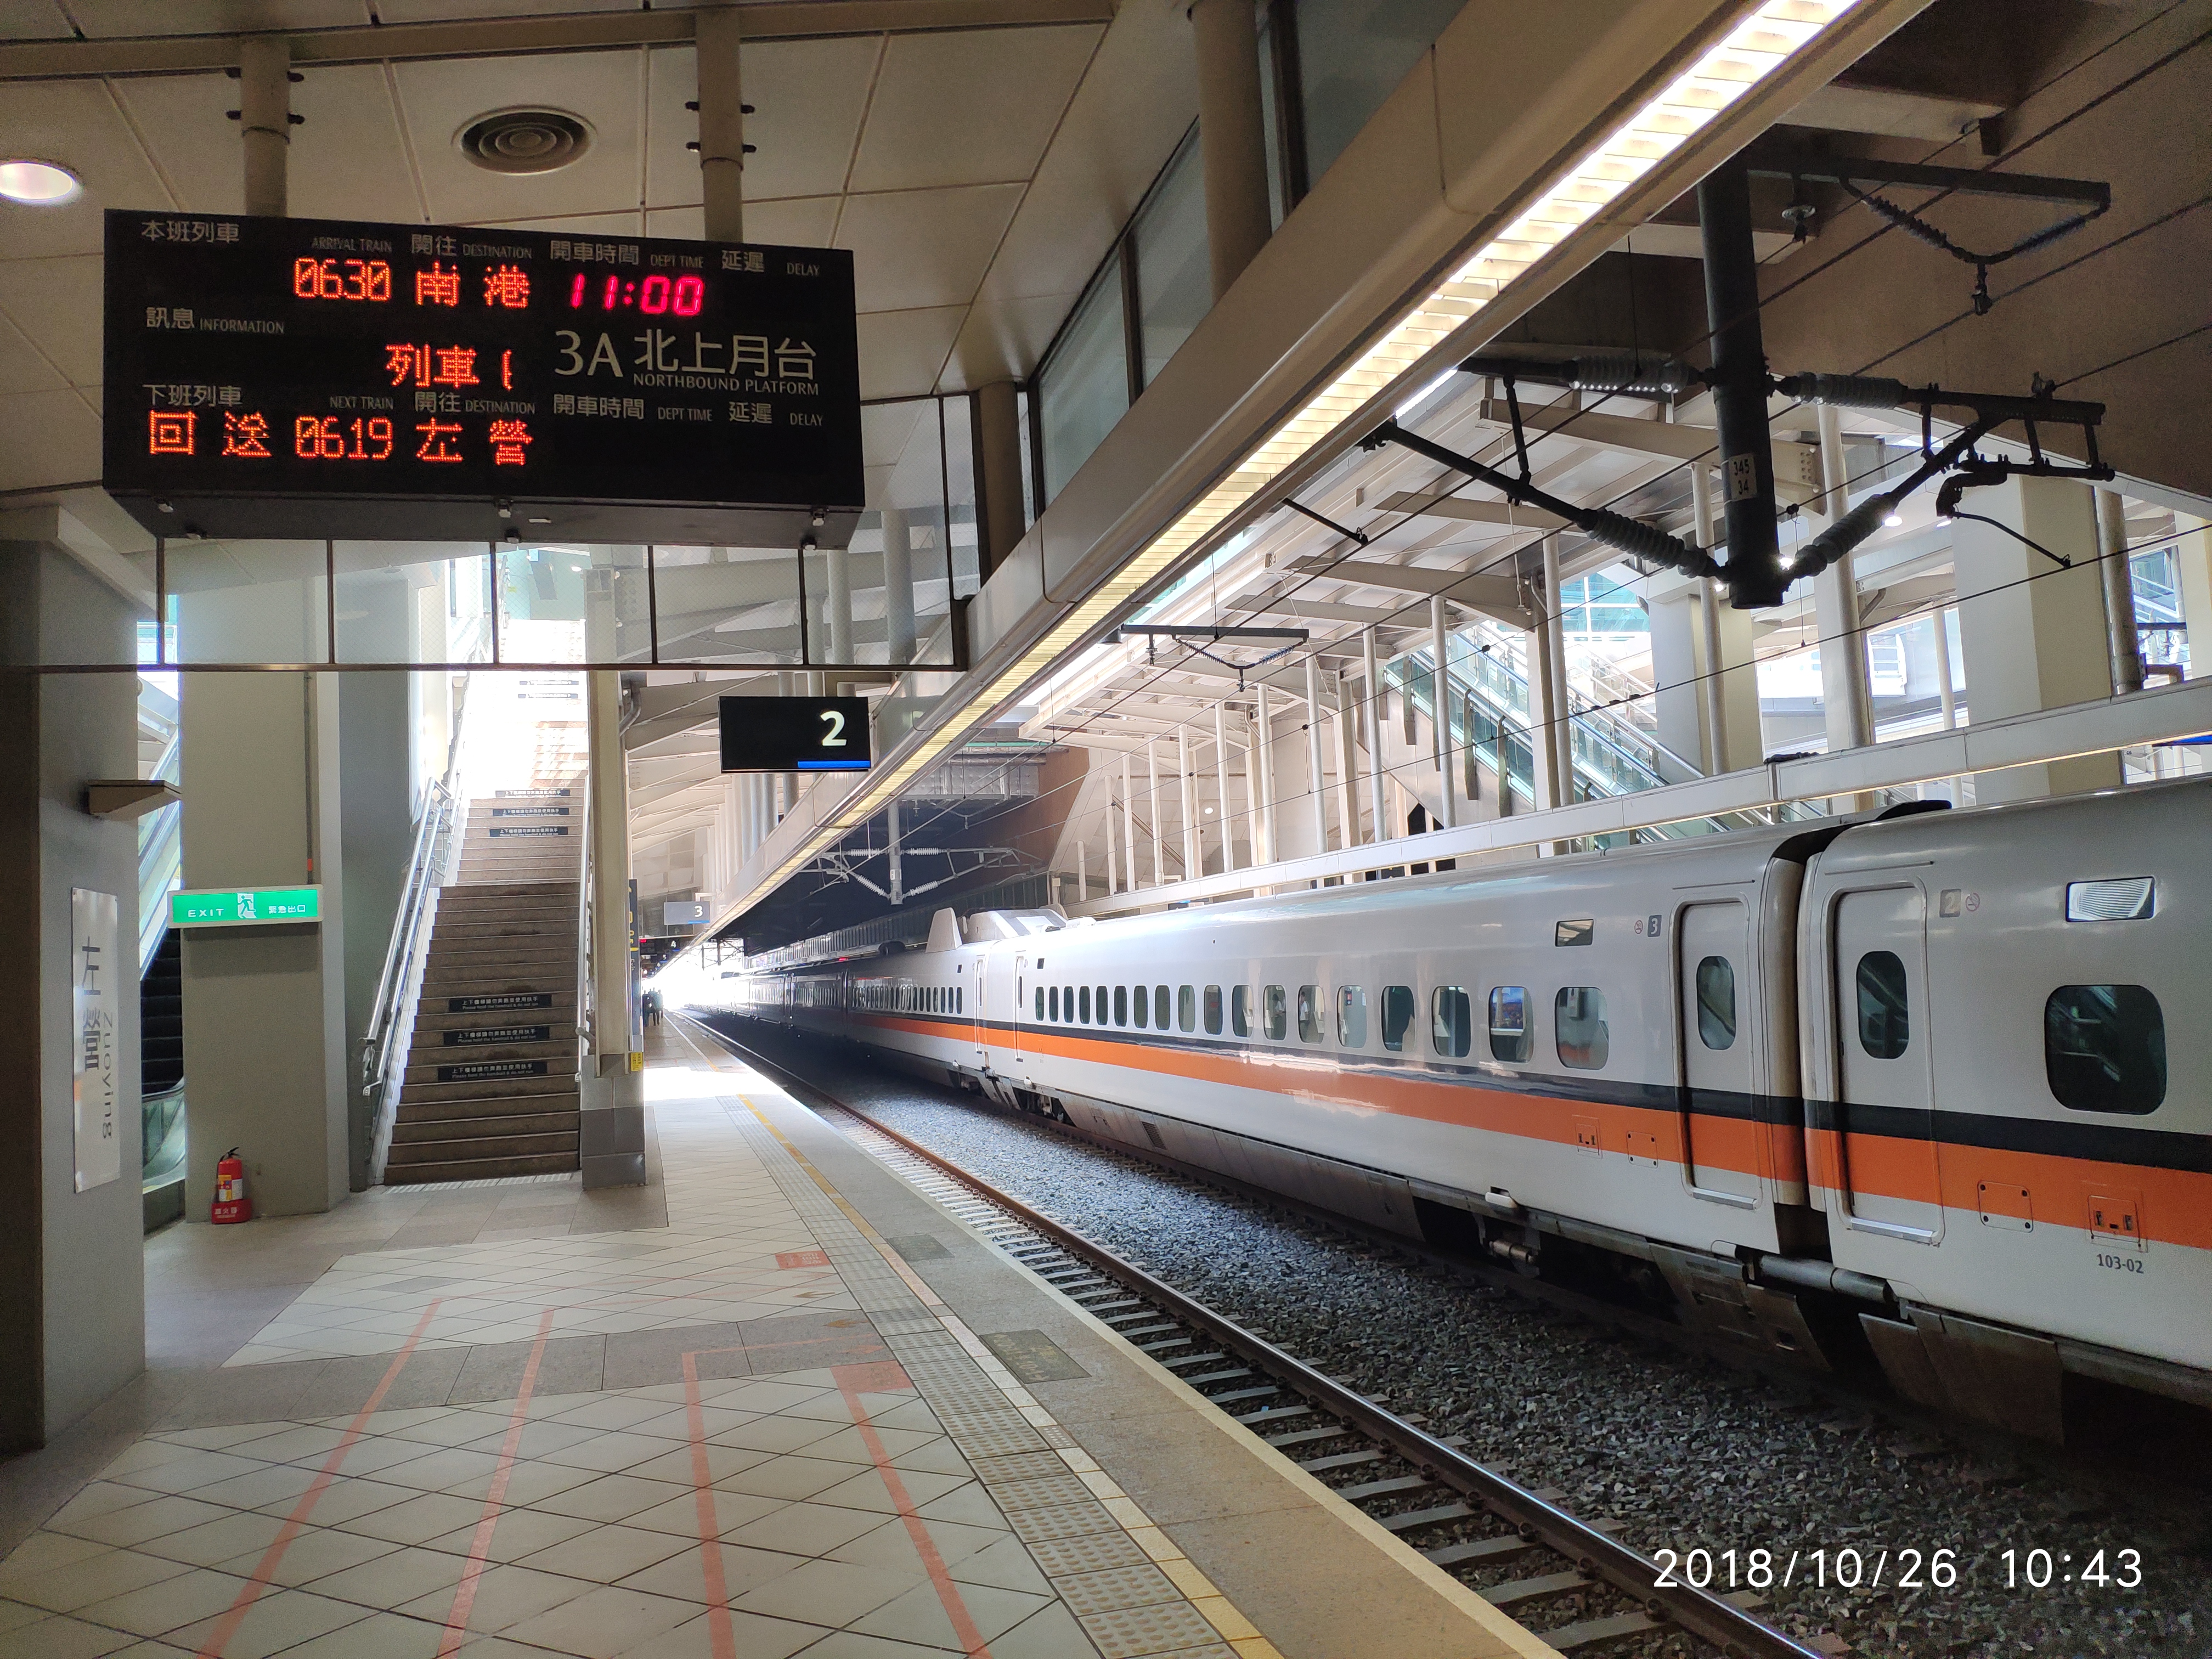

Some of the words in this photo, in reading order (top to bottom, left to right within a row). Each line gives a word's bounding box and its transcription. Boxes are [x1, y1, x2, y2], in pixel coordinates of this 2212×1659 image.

[141, 221, 240, 243] 本班列車
[312, 237, 356, 251] ARRIVAL
[360, 239, 392, 253] TRAIN
[411, 234, 456, 256] 開往
[462, 244, 532, 259] DESTINATION
[550, 240, 639, 266] 開車時間
[650, 254, 676, 267] DEPT
[680, 255, 704, 269] TIME
[722, 249, 765, 273] 延遲
[787, 262, 819, 276] DELAY
[294, 257, 391, 301] 0630
[570, 273, 704, 317] 11:00
[145, 307, 195, 330] 訊息
[200, 318, 285, 334] INFORMATION
[554, 330, 624, 378] 3A
[634, 329, 816, 381] 北上月台
[633, 373, 740, 392] NORTHBOUND
[745, 379, 819, 396] PLATFORM
[143, 385, 243, 407] 下班列車
[330, 396, 357, 410] NEXT
[361, 397, 393, 411] TRAIN
[415, 391, 461, 413] 開往
[465, 399, 535, 414] DESTINATION
[554, 393, 645, 420] 開車時間
[658, 407, 685, 421] DEPT
[688, 408, 713, 422] TIME
[729, 401, 773, 425] 延遲
[790, 413, 823, 427] DELAY
[295, 415, 393, 460] 0619
[1734, 459, 1750, 476] 345
[820, 710, 847, 746] 2
[188, 908, 224, 918] EXIT
[268, 905, 306, 915] 緊急出口
[694, 906, 703, 917] 3
[1944, 892, 1956, 914] 2
[1651, 918, 1658, 934] 3
[82, 936, 101, 1072] 左營
[102, 1012, 114, 1139] Zuoying
[2097, 1254, 2145, 1274] 103-02
